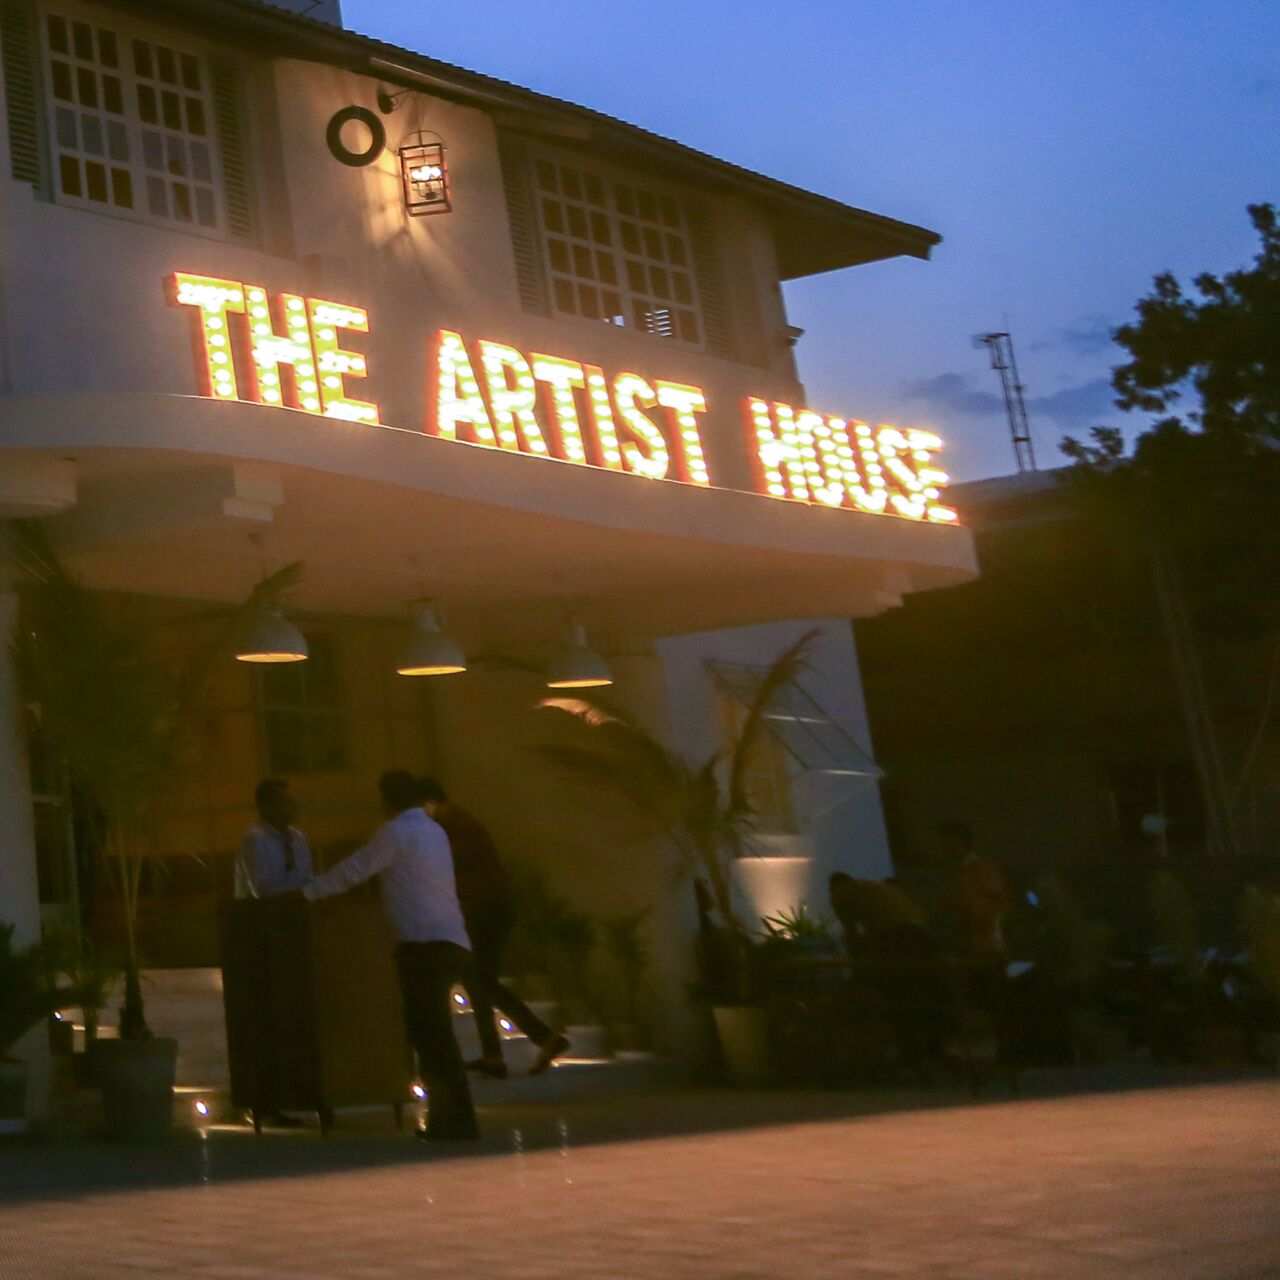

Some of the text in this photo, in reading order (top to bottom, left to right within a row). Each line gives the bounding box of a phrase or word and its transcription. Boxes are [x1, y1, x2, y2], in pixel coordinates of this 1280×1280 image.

[167, 271, 960, 526] THE ARTIST HOUSE
